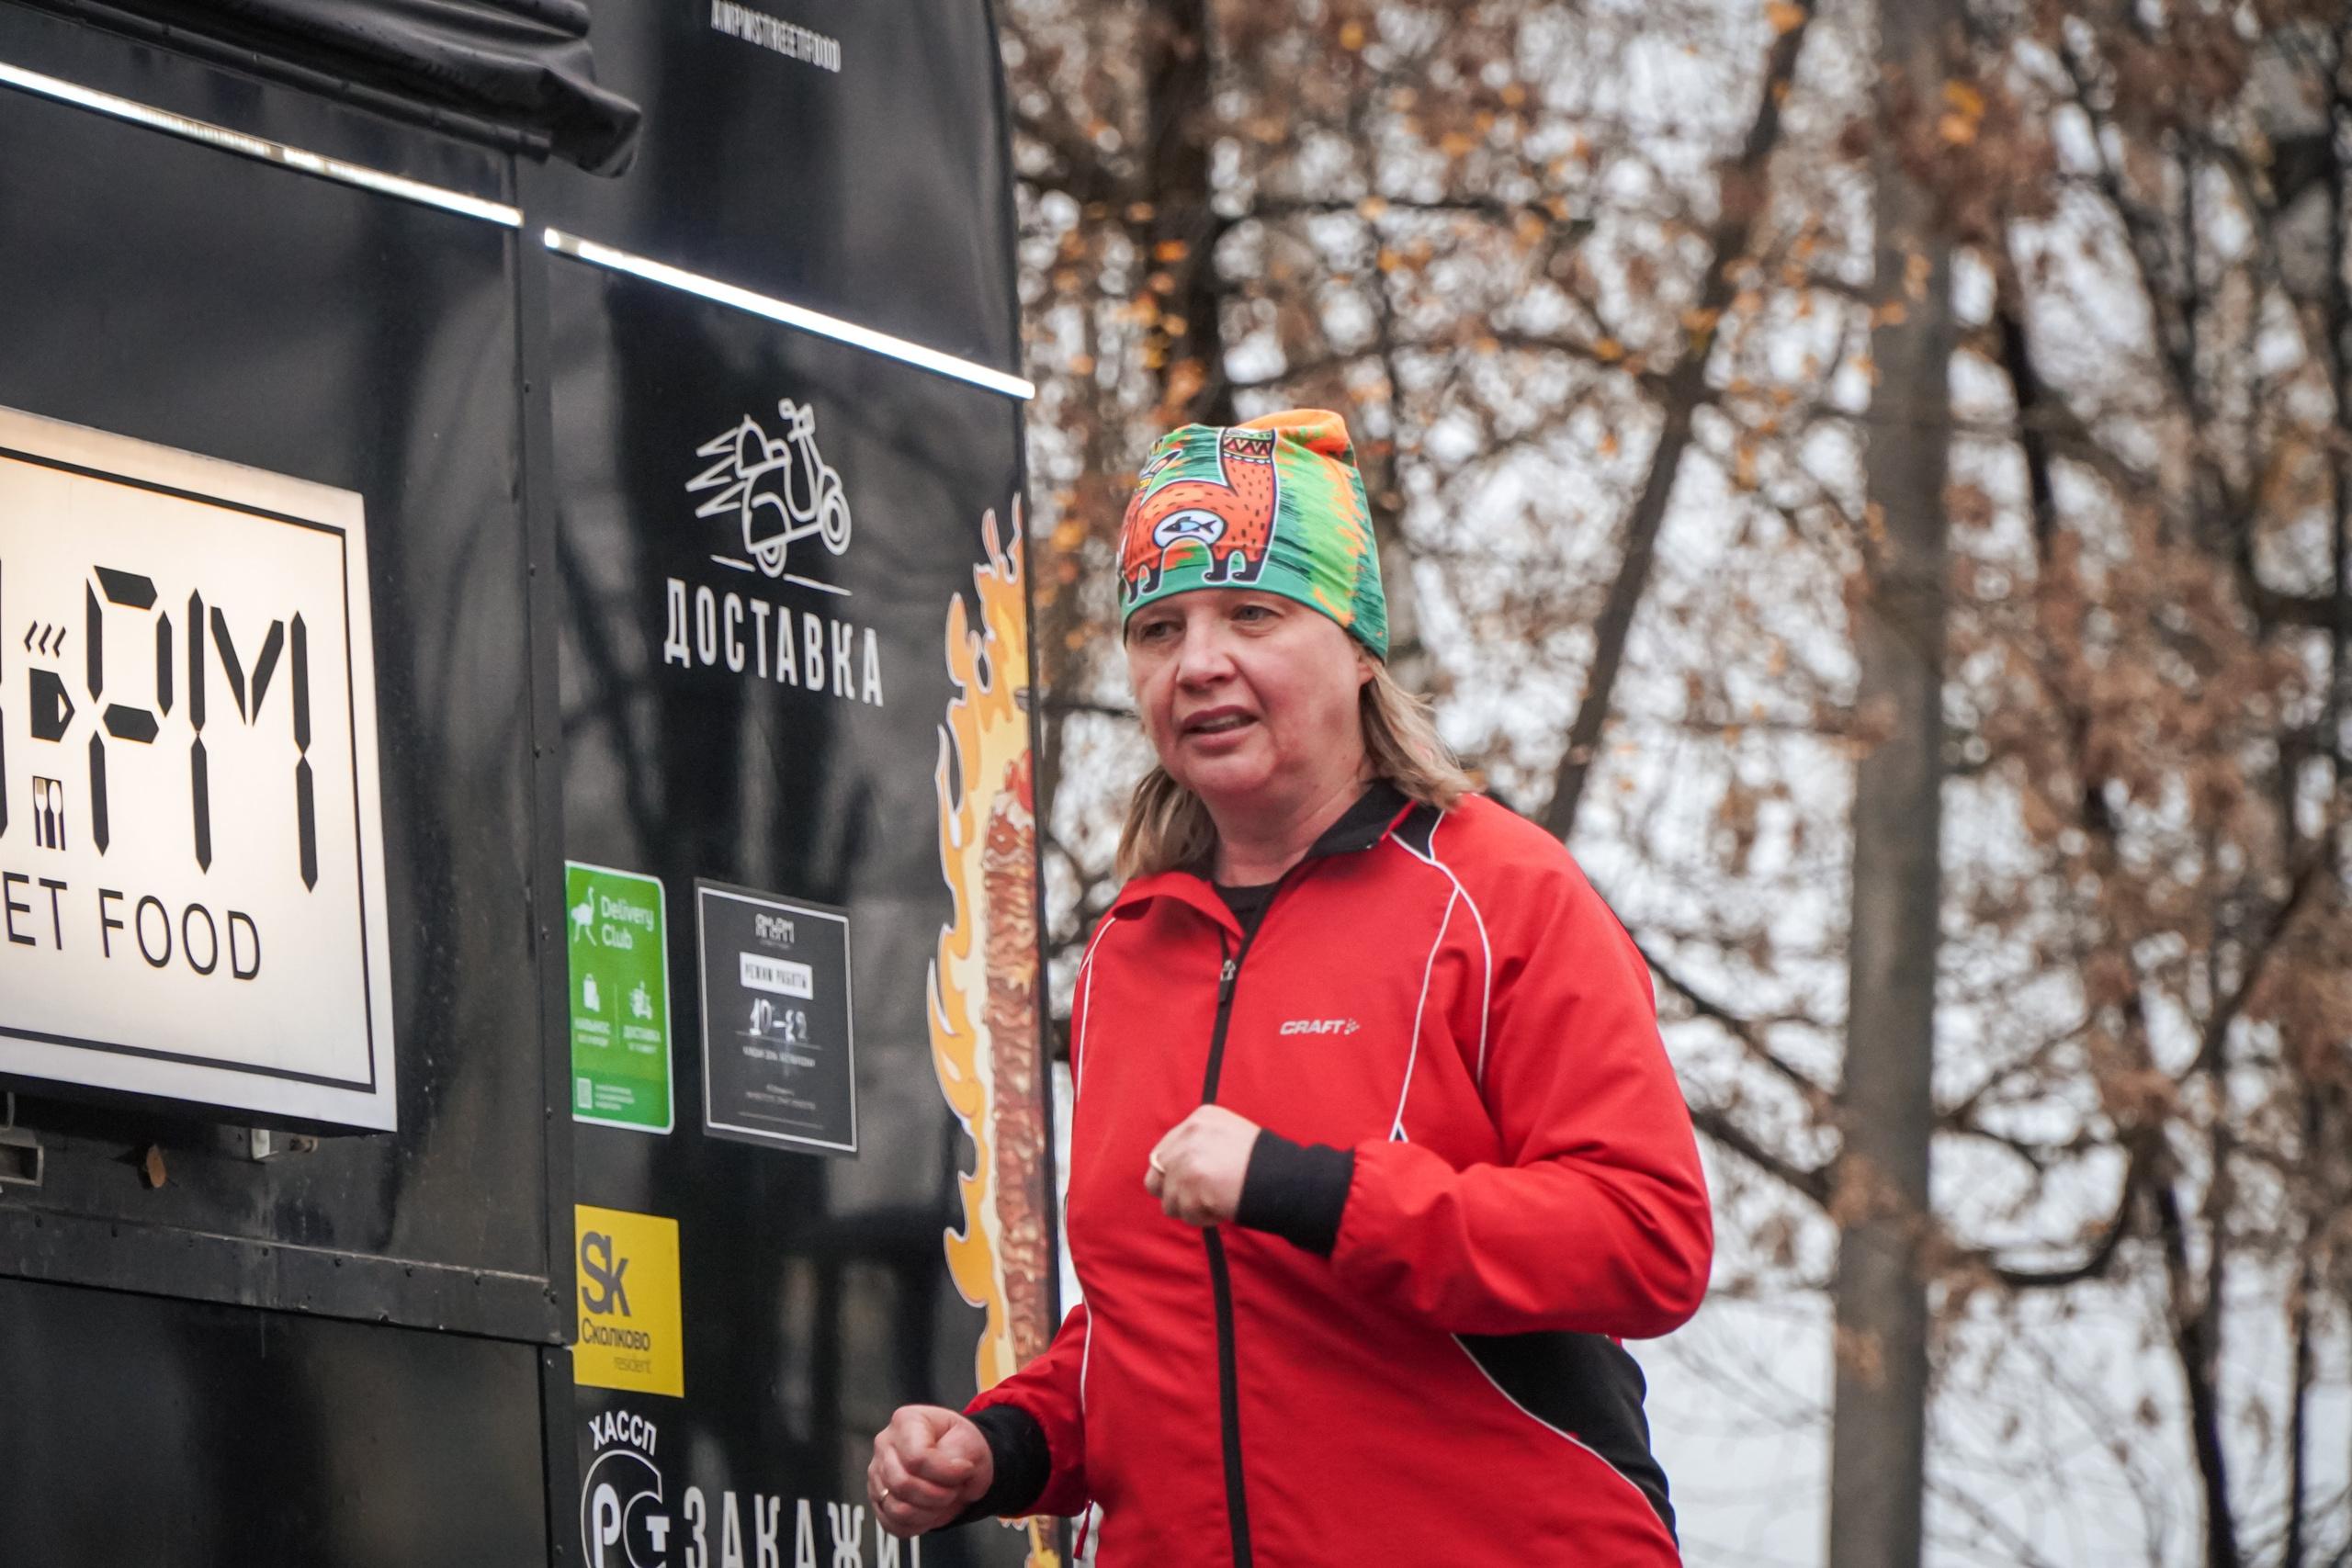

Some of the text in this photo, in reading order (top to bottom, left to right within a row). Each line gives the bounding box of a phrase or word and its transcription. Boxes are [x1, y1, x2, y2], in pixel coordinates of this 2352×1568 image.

[663, 577, 884, 707] ДОСТАВКА
[97, 887, 261, 981] FOOD
[600, 895, 654, 932] Delivery
[601, 923, 633, 950] Club
[1280, 1019, 1346, 1035] CRAFT
[580, 1231, 631, 1317] Sk
[582, 1317, 651, 1352] Сколково
[588, 1409, 658, 1457] ХАССП
